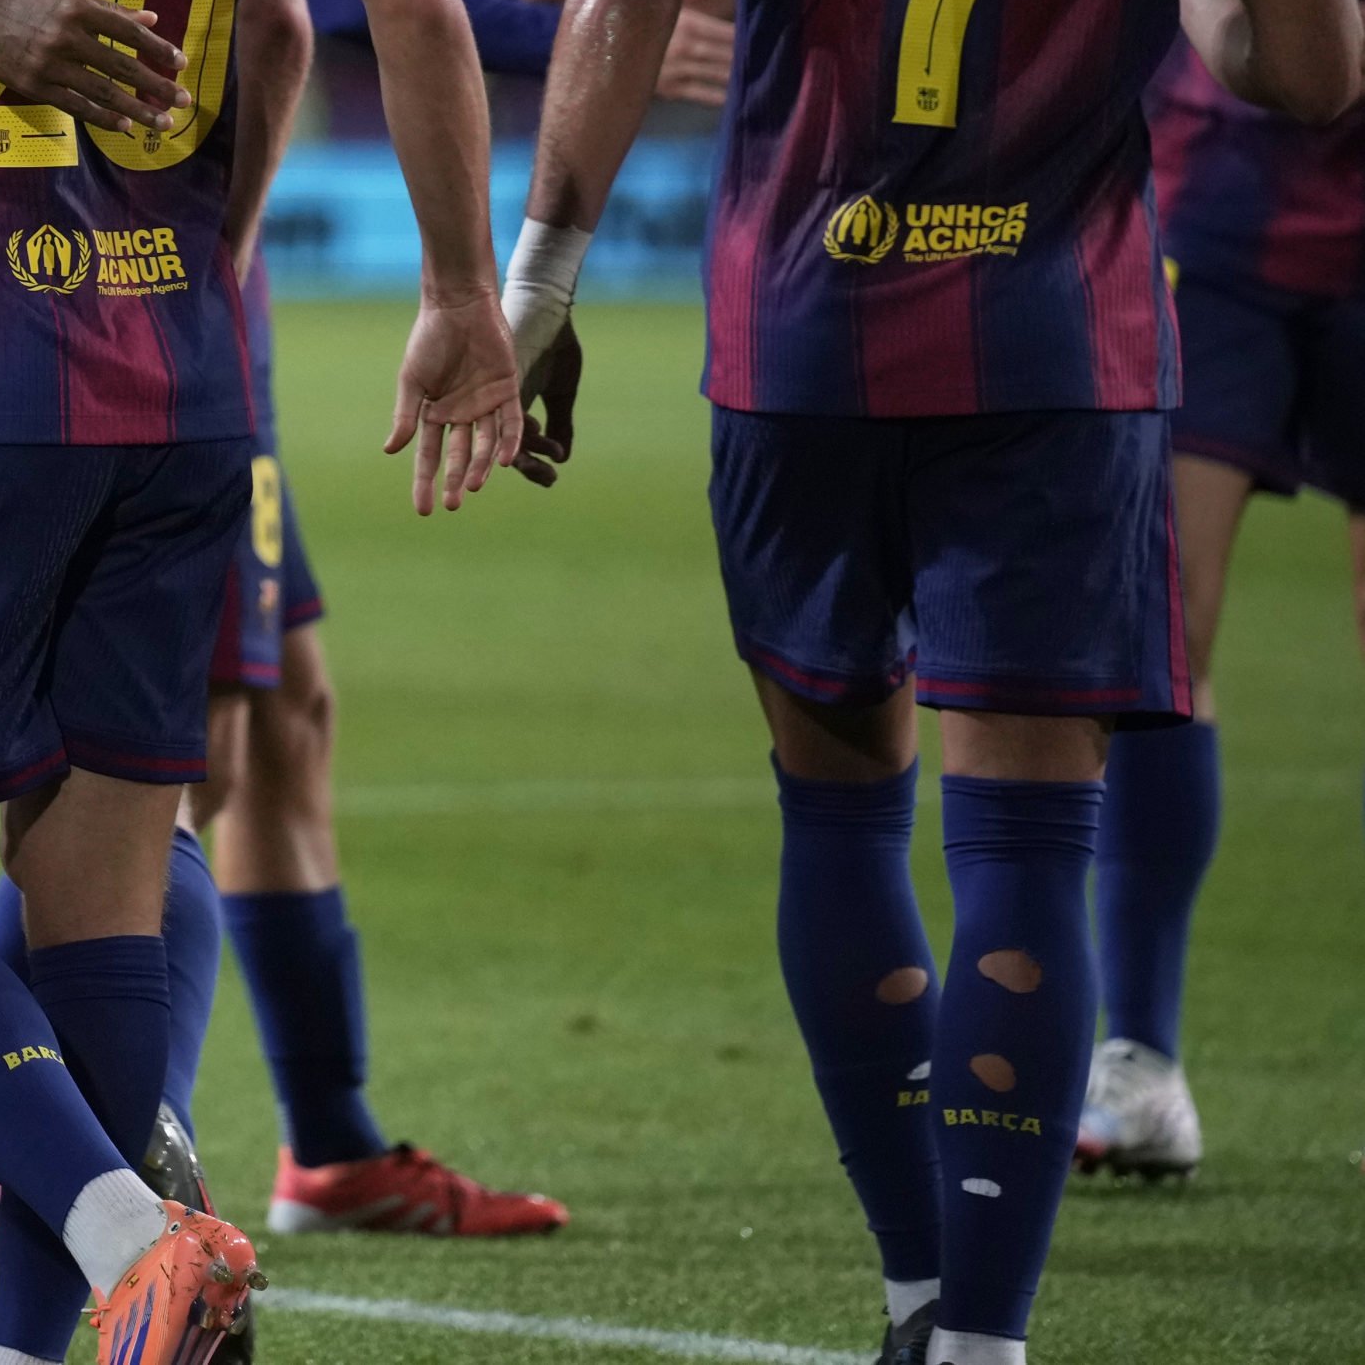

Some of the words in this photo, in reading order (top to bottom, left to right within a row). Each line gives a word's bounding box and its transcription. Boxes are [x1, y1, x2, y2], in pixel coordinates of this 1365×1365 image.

[92, 227, 178, 257] UNHCR
[902, 219, 1027, 253] ACNUR
[96, 254, 186, 285] ACNUR
[152, 281, 189, 295] Agency
